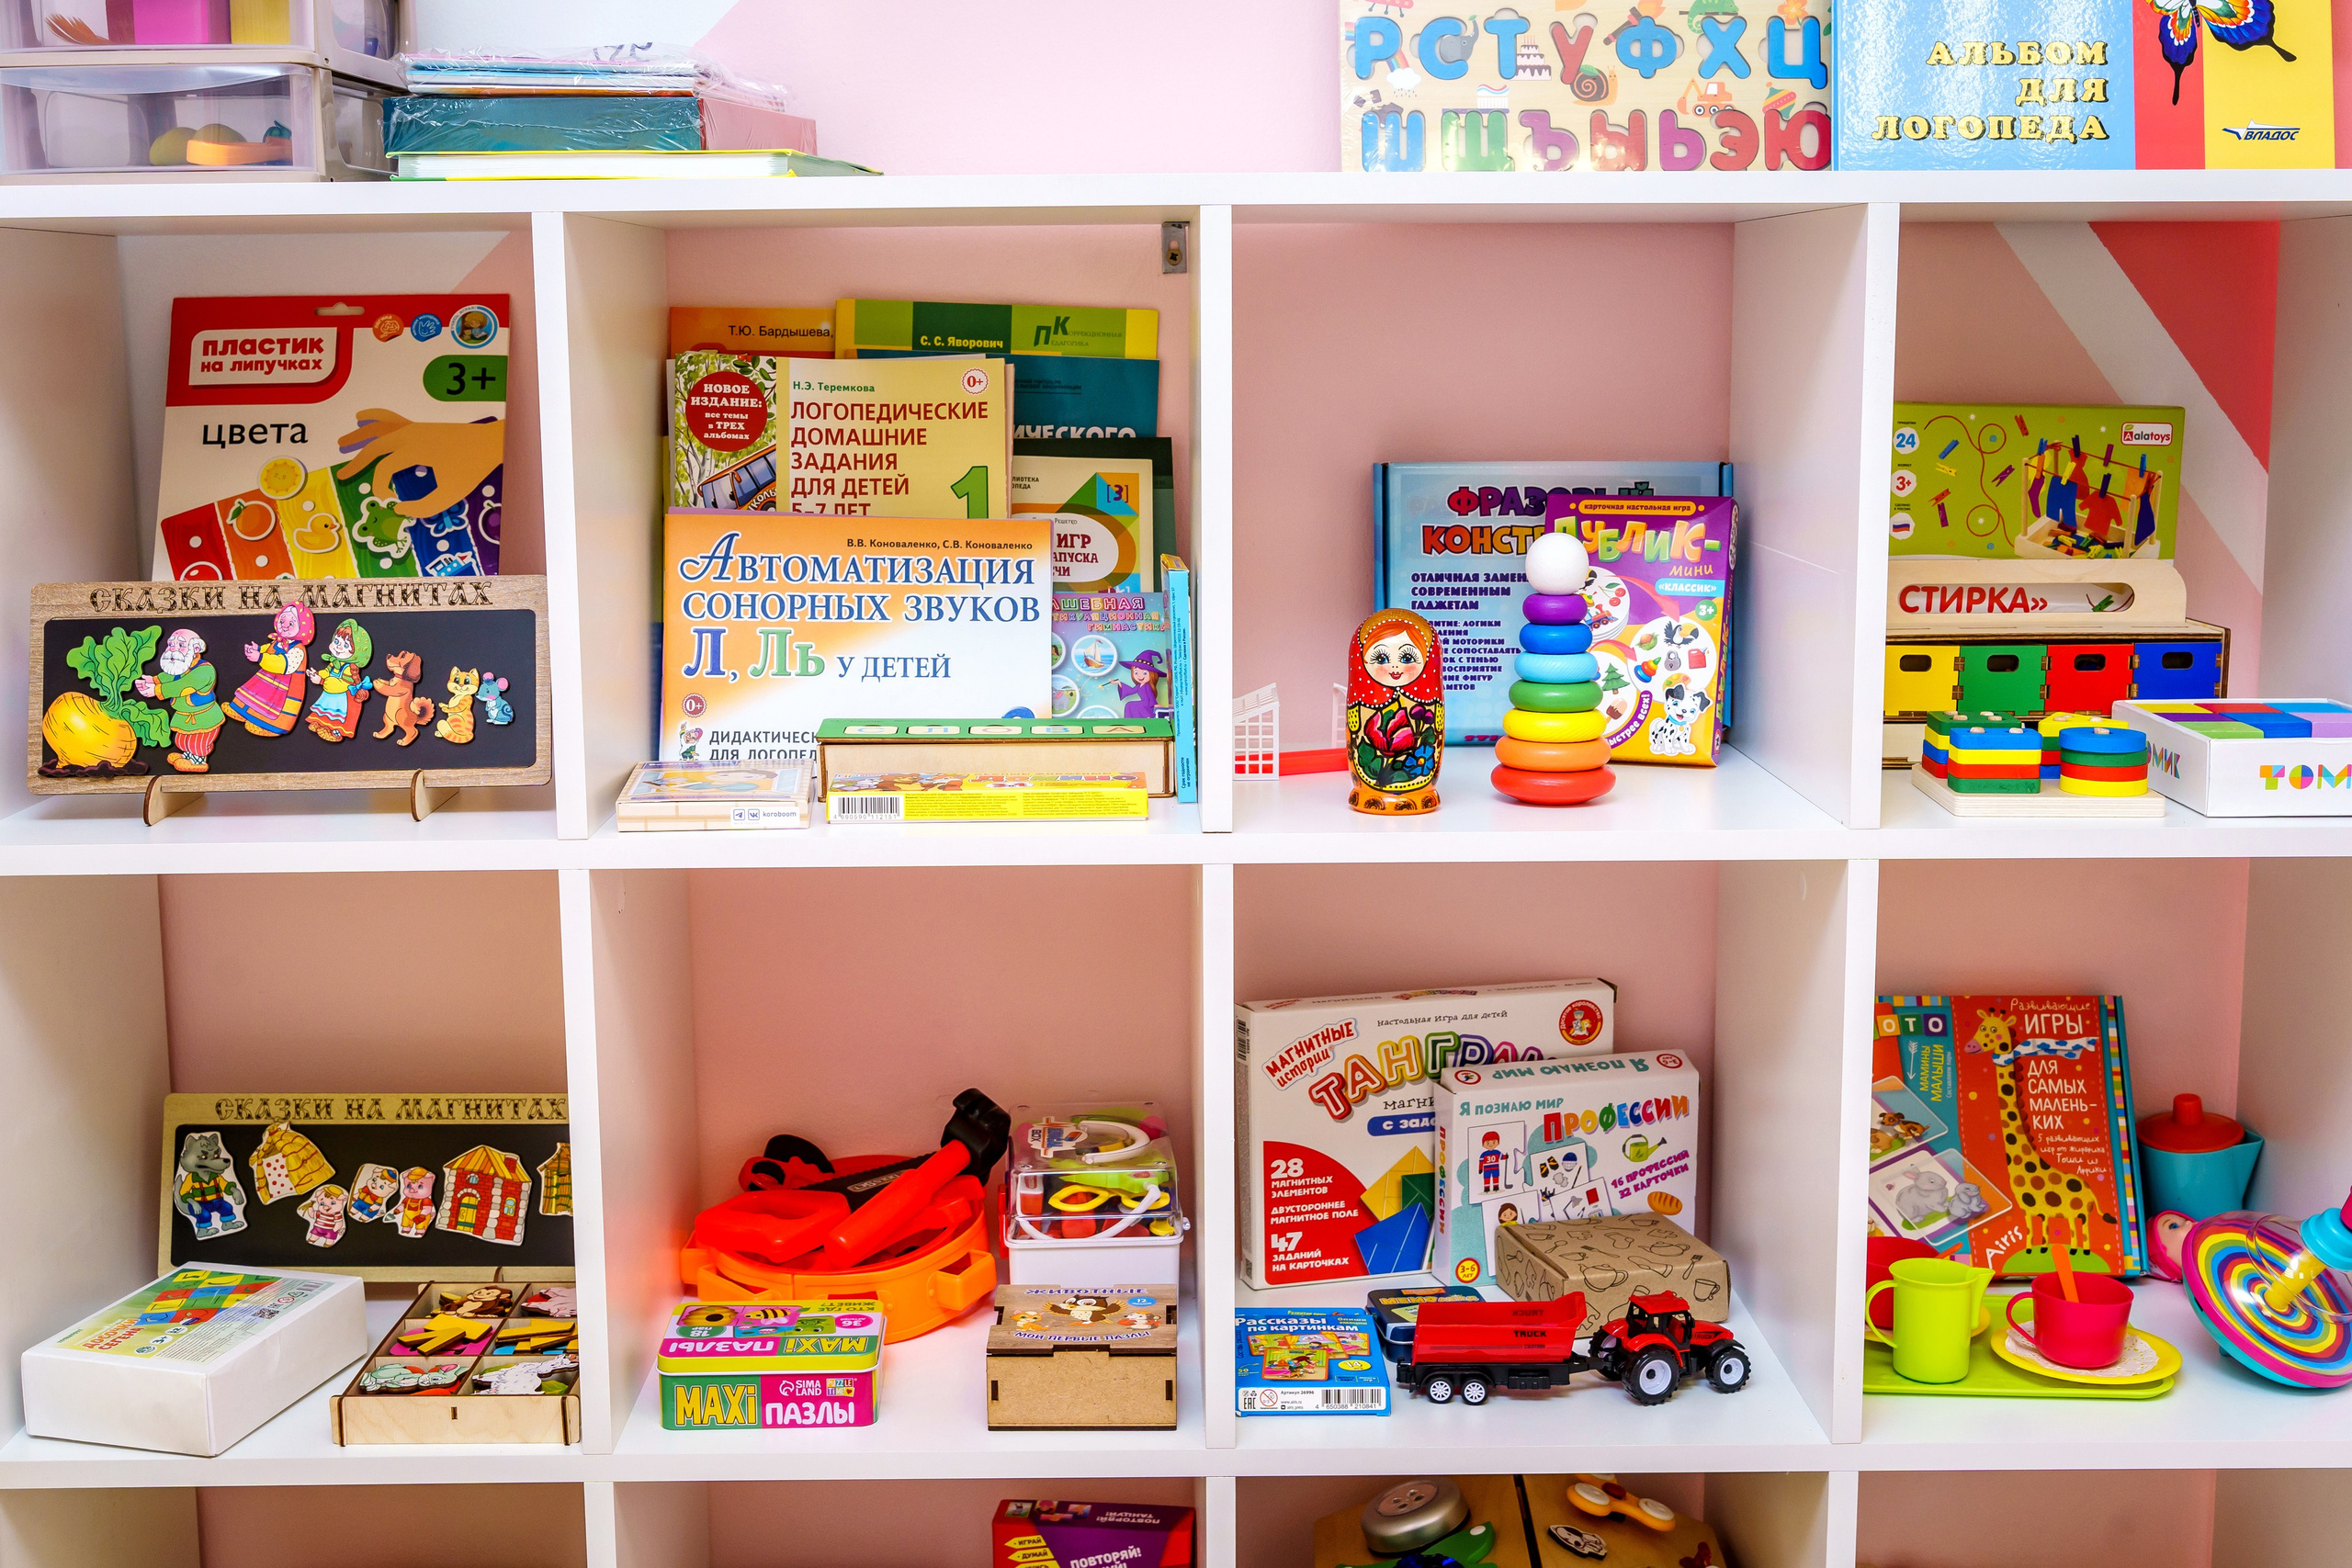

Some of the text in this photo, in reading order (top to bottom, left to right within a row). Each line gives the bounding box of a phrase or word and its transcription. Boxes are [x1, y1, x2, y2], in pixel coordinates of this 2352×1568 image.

[1926, 39, 2109, 66] АЛЬБОМ
[2015, 77, 2109, 107] ДЛЯ
[1871, 115, 2109, 144] ЛОГОПЕДА
[2243, 130, 2299, 142] ВЛАДОС
[728, 325, 834, 338] Т.Ю. Бардышева,
[202, 336, 324, 356] пластик
[920, 335, 1003, 350] С. С. Яворович
[200, 358, 322, 376] на липучках
[446, 362, 496, 396] 3+
[967, 376, 983, 388] 0+
[703, 383, 750, 395] НОВОЕ
[793, 381, 875, 394] Н.Э. Теремкова
[691, 396, 763, 408] ИЗДАНИЕ:
[705, 412, 721, 420] все
[791, 401, 989, 423] ЛОГОПЕДИЧЕСКИЕ
[716, 422, 745, 431] ТРЕХ
[202, 422, 308, 449] цвета
[703, 432, 750, 440] альбомах
[791, 427, 927, 447] ДОМАШНИЕ
[1895, 433, 1917, 448] 24
[791, 452, 898, 474] ЗАДАНИЯ
[791, 473, 910, 499] ДЛЯ ДЕТЕЙ
[1895, 475, 1912, 491] 3+
[951, 466, 989, 519] 1
[1584, 503, 1691, 513] карточная настольная игра
[846, 538, 1033, 550] В.В. Коноваленко, С.В. Коноваленко
[1057, 533, 1091, 549] ИГР
[679, 532, 1035, 590] АВТОМАТИЗАЦИЯ
[1411, 572, 1530, 582] ОТЛИЧНАЯ ЗАМЕН
[1669, 563, 1713, 578] мини
[1411, 587, 1510, 596] СОВРЕМЕННЫМ
[1658, 581, 1717, 593] «КЛАССИК»
[89, 581, 493, 614] СКАЗКИ НА МАГНИТАХ
[1411, 600, 1479, 610] ГАДЖЕТАМ
[1898, 585, 2048, 615] СТИРКА»
[683, 592, 1040, 623] СОНОРНЫХ ЗВУКОВ
[1699, 604, 1714, 616] 3+
[684, 628, 738, 682] Л,
[749, 628, 825, 677] Ль
[862, 654, 951, 682] ДЕТЕЙ
[685, 699, 703, 712] 0+
[709, 749, 740, 761] ДЛЯ
[2010, 998, 2091, 1012] Развивающие
[2024, 1012, 2084, 1035] ИГРЫ
[1265, 1021, 1354, 1077] МАГНИТНЫЕ
[1276, 1045, 1335, 1089] истории
[1919, 1044, 1931, 1092] МАМИНЫ
[1930, 1043, 1944, 1102] МАЛЫШИ
[2027, 1059, 2058, 1078] ДЛЯ
[2028, 1078, 2087, 1095] САМЫХ
[214, 1098, 334, 1122] СКАЗКИ
[345, 1098, 385, 1121] НА
[1459, 1098, 1565, 1117] Я ПОЗНАЮ МИР
[2029, 1098, 2098, 1113] МАЛЕНЬ-
[1544, 1095, 1689, 1143] ПРОФЕССИИ
[2032, 1114, 2064, 1131] КИХ
[1486, 1155, 1497, 1163] 30
[1270, 1157, 1304, 1179] 28
[1611, 1149, 1690, 1190] 16 ПРОФЕССИЙ
[1272, 1175, 1333, 1189] МАГНИТНЫХ
[1618, 1163, 1690, 1200] 32 КАРТОЧКИ
[1271, 1186, 1329, 1199] ЭЛЕМЕНТОВ
[1271, 1201, 1346, 1215] ДВУСТОРОННЕЕ
[1270, 1209, 1359, 1225] МАГНИТНОЕ ПОЛЕ
[1271, 1231, 1303, 1252] 47
[1985, 1225, 2023, 1270] Airis
[1272, 1248, 1322, 1262] ЗАДАНИЙ
[1272, 1257, 1349, 1272] НА КАРТОЧКАХ
[1460, 1264, 1476, 1273] 3-6
[841, 1319, 862, 1327] 36
[1235, 1317, 1327, 1325] Рассказы
[689, 1329, 710, 1337] 18
[1013, 1331, 1151, 1342] МОИ ПЕРВЫЕ ПАЗЛЫ
[1270, 1325, 1359, 1333] картинкам
[1513, 1330, 1547, 1338] TRUCK
[669, 1340, 775, 1352] ПАЗЛЫ
[796, 1380, 821, 1388] SIMA
[826, 1378, 854, 1388] PUZZLE
[796, 1388, 822, 1396] LAND
[764, 1402, 855, 1426] ПАЗЛЫ
[1018, 1537, 1043, 1547] ИГРАЙ
[1022, 1550, 1048, 1561] ДУМАЙ
[1069, 1546, 1142, 1568] ПОВТОРЯЙ!
